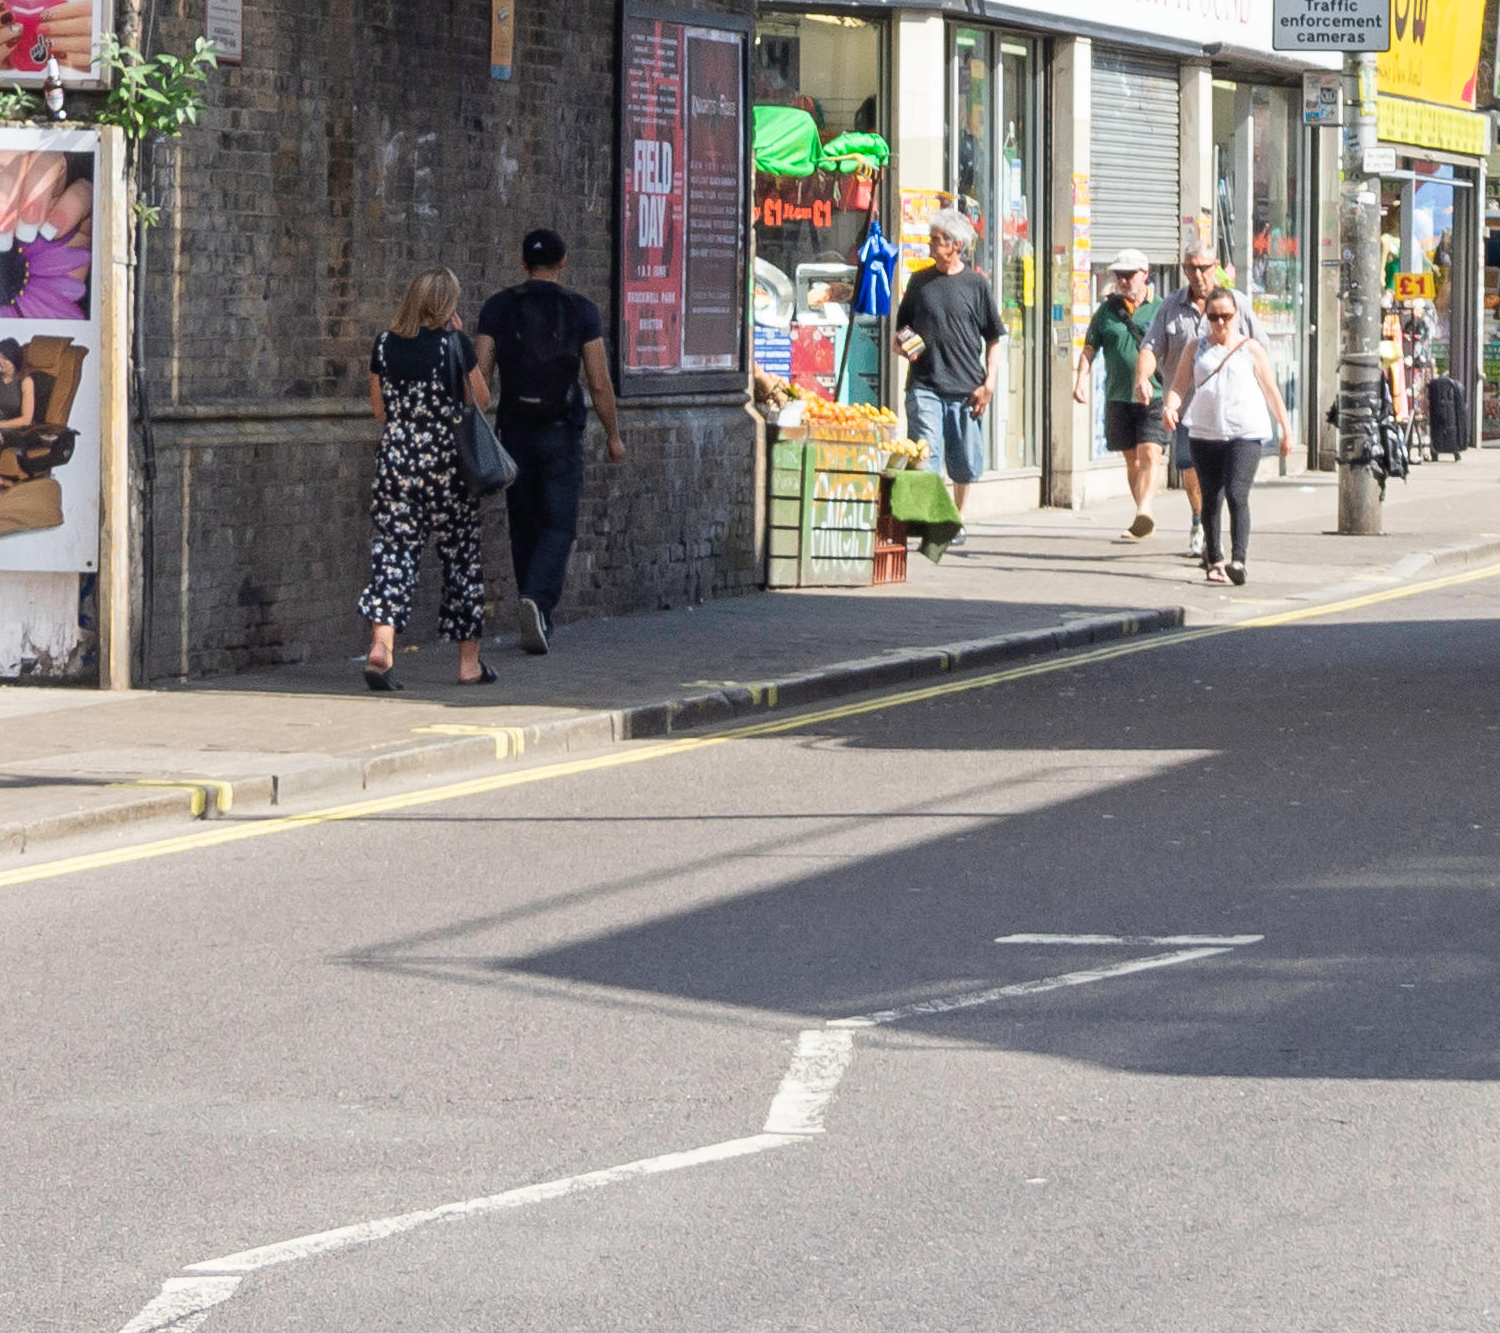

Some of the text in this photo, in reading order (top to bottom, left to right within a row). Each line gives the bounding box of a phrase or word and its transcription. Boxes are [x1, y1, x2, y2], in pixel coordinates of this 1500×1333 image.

[1280, 14, 1382, 28] enforcement
[1296, 30, 1366, 44] cameras
[634, 139, 673, 194] FIELD
[638, 194, 667, 248] DAY
